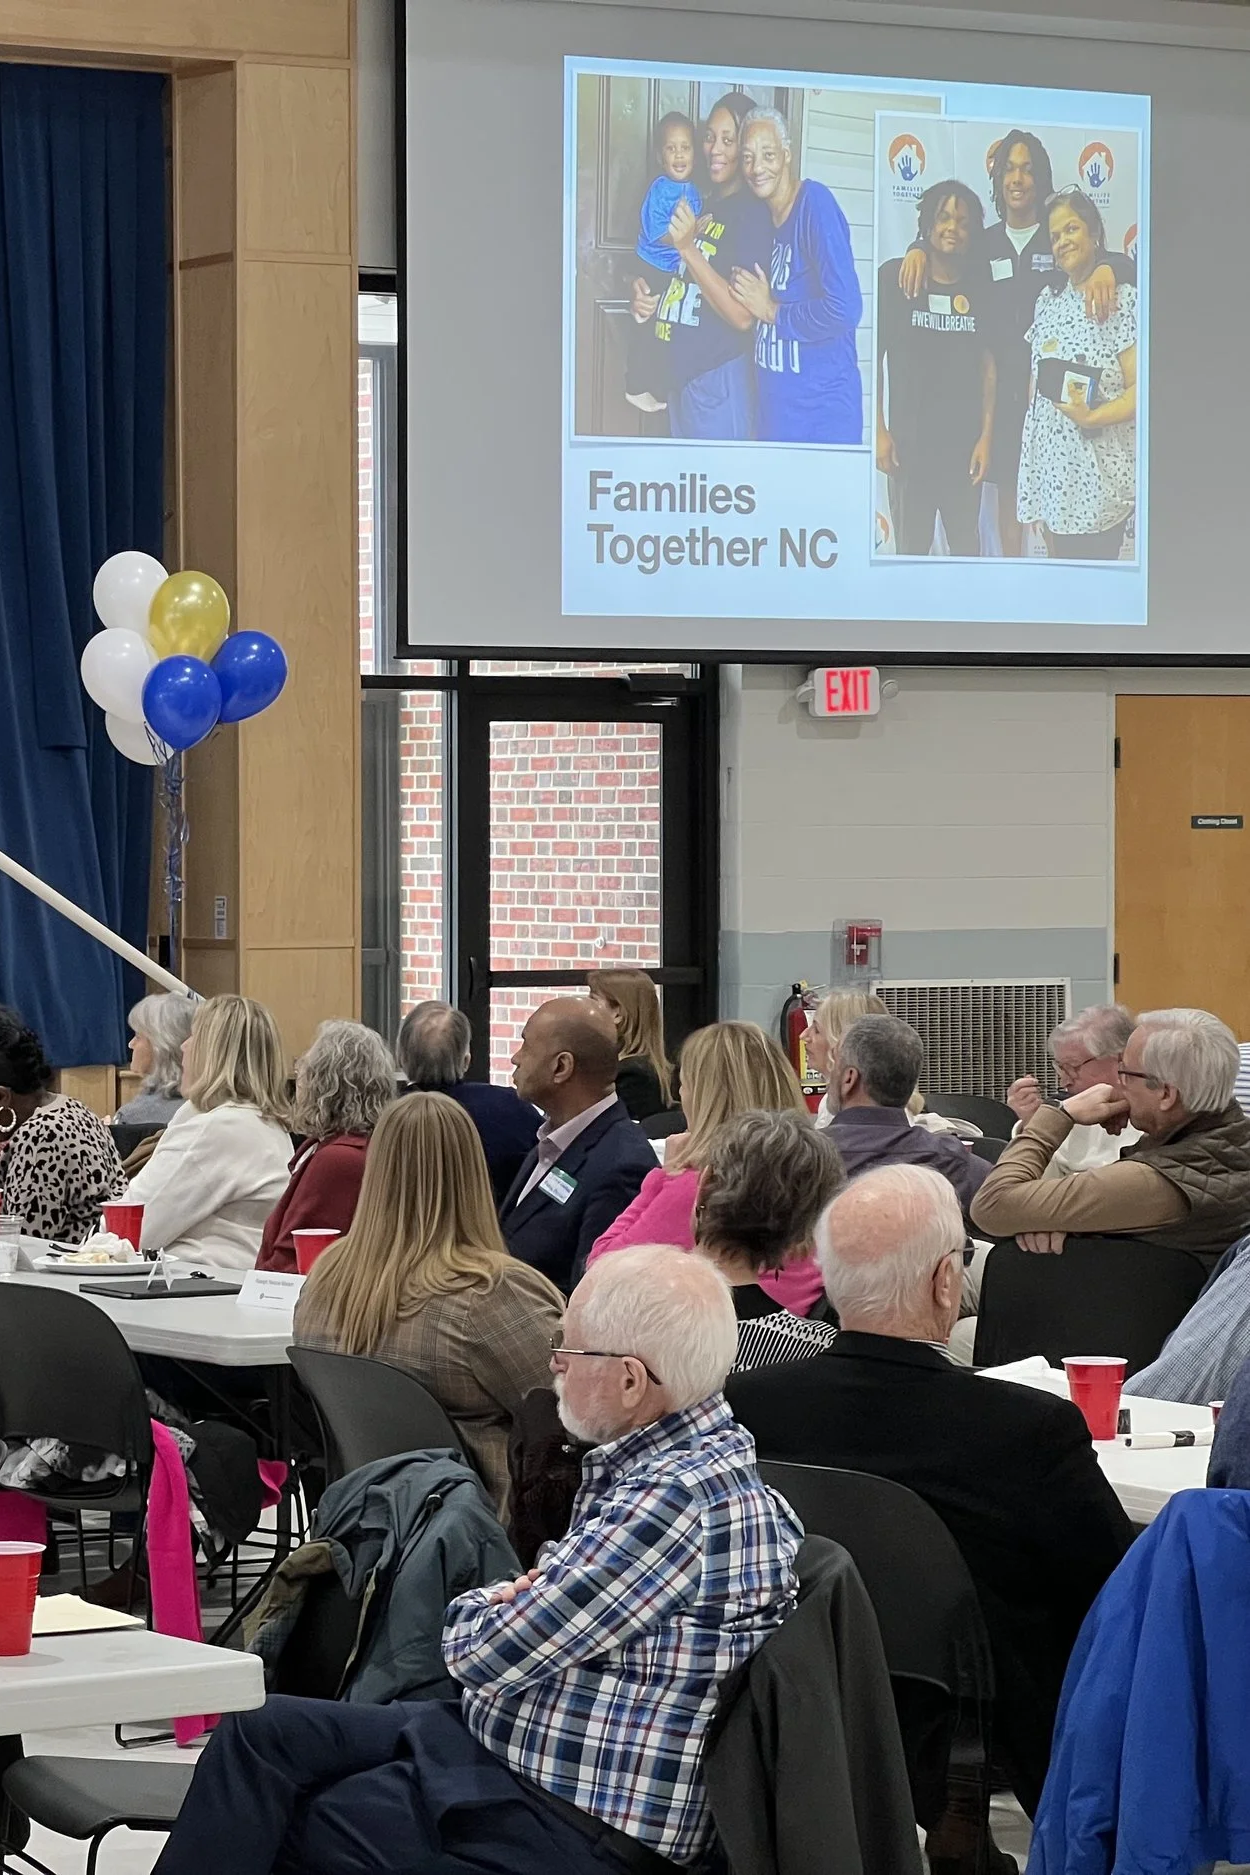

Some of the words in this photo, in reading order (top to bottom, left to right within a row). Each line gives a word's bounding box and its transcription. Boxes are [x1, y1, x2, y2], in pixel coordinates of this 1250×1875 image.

[911, 310, 976, 332] #WEWILLBREATHE
[589, 470, 756, 514] Families
[587, 523, 768, 575] Together
[779, 527, 838, 569] NC
[825, 669, 872, 713] EXIT
